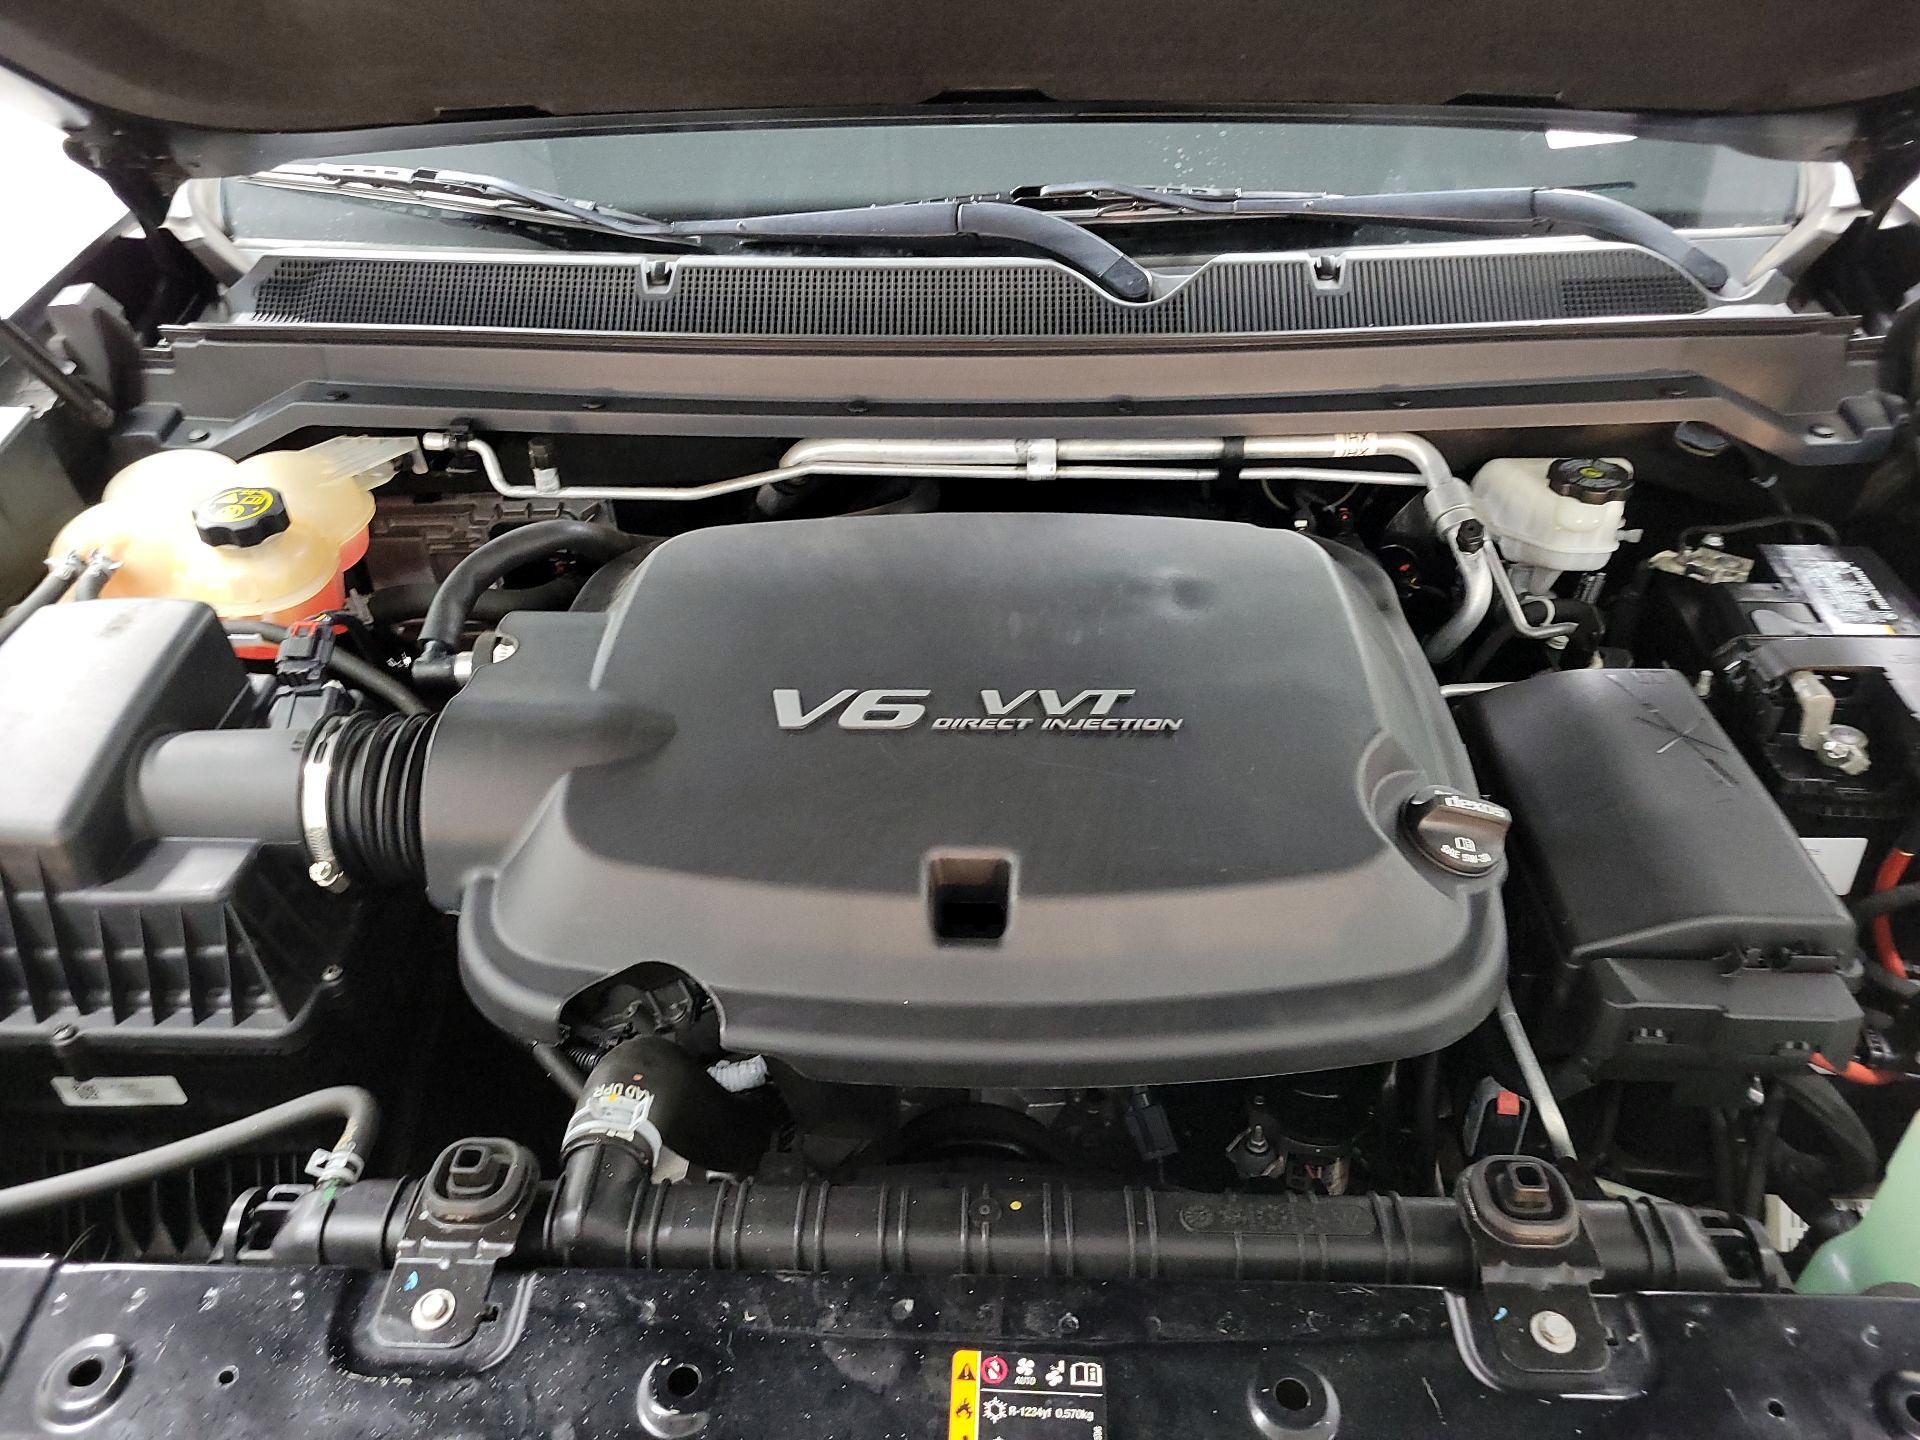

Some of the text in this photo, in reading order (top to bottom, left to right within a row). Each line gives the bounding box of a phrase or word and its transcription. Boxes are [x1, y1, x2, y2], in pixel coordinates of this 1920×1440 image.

[773, 688, 1137, 730] V6 VVT
[931, 717, 1184, 731] DIRECT INJECTION
[1440, 844, 1492, 863] SAE 5W-30
[1014, 1376, 1037, 1386] AUTO
[1054, 1408, 1095, 1422] 0.570kg
